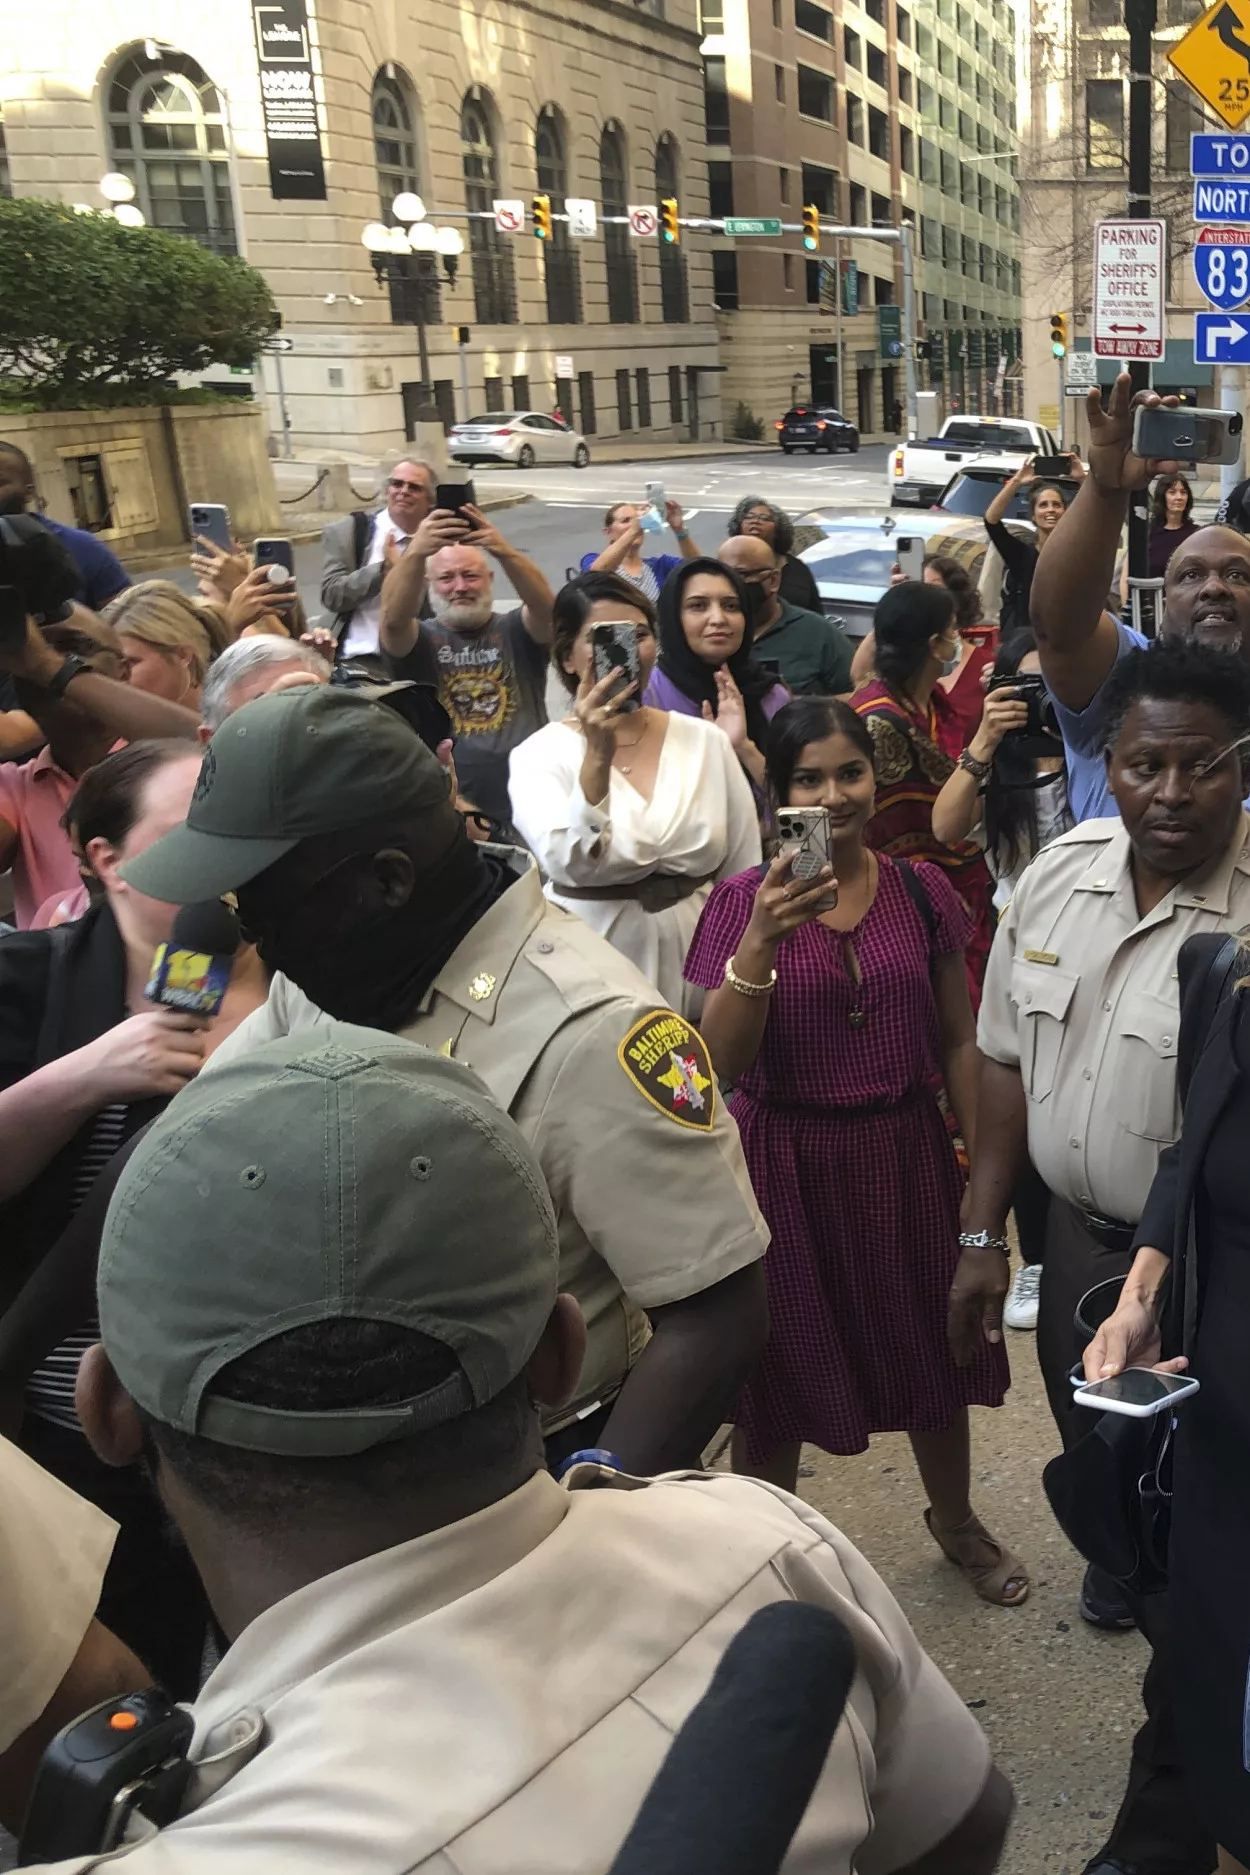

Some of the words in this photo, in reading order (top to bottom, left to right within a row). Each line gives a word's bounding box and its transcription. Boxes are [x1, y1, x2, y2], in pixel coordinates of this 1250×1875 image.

[1218, 78, 1250, 101] 25
[1224, 102, 1244, 112] MPH
[1211, 141, 1249, 168] TO
[1101, 228, 1158, 246] PARKING
[1119, 247, 1138, 261] FOR
[1100, 263, 1158, 279] SHERIFF'S
[1207, 248, 1249, 299] 83
[1108, 281, 1149, 297] OFFICE
[1097, 339, 1116, 355] TOW
[1116, 340, 1138, 356] AWAY
[1138, 341, 1160, 357] ZONE
[638, 1029, 689, 1075] SHERIFF
